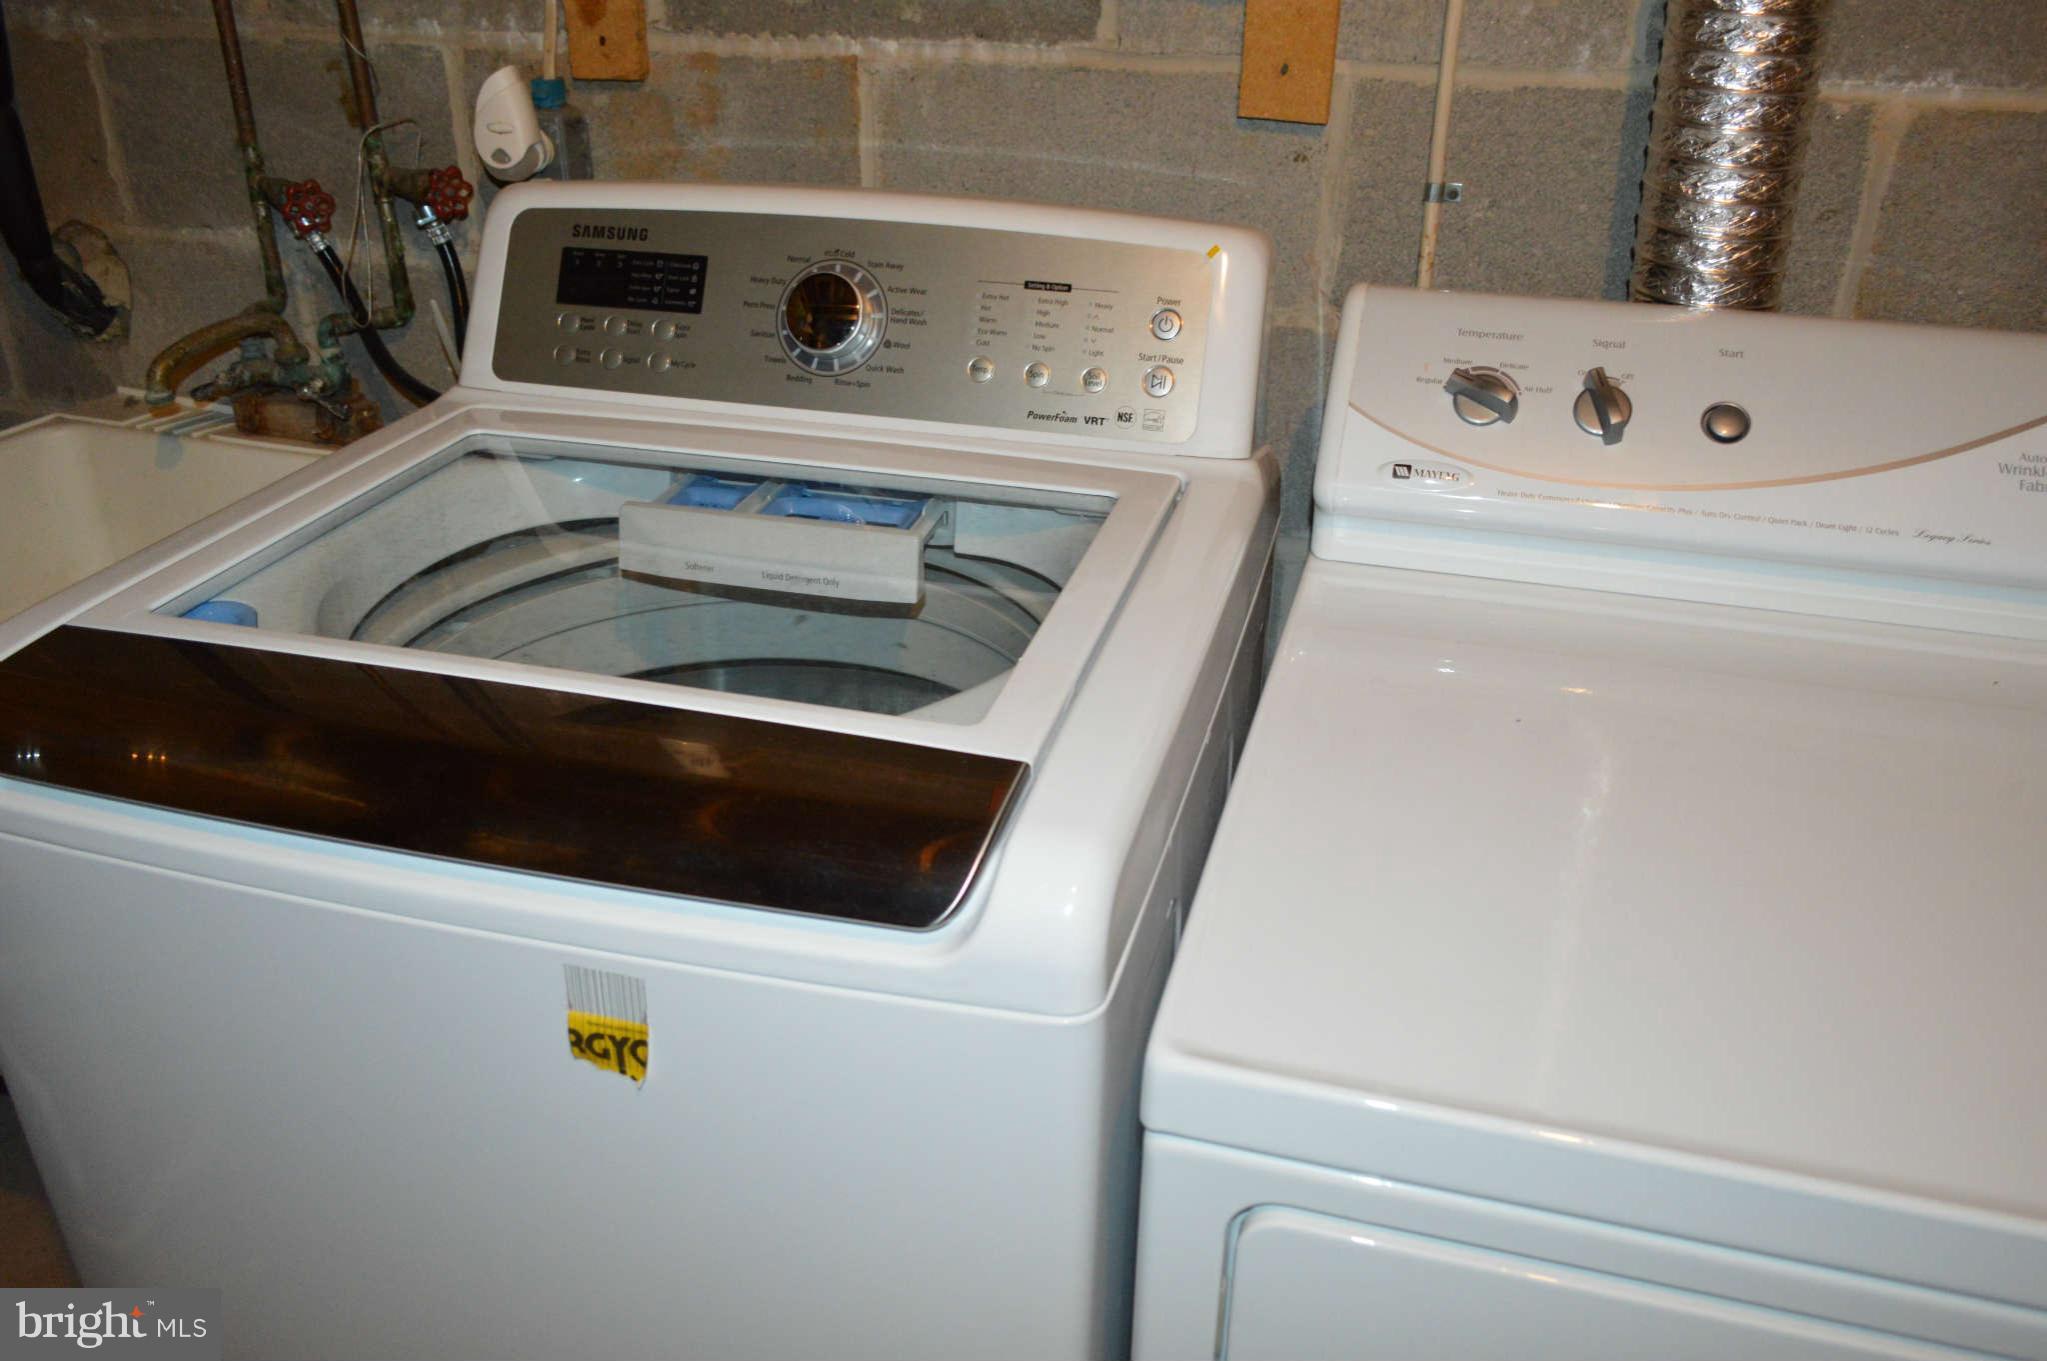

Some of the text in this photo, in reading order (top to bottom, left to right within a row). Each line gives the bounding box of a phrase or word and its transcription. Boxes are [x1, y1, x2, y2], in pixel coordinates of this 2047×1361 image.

[572, 224, 649, 242] SAMSUNG
[888, 286, 927, 295] Active Wear
[1156, 296, 1181, 306] Power
[890, 317, 927, 326] Hand Wash
[1091, 325, 1114, 334] Normal
[1457, 327, 1525, 341] Temperature
[1593, 338, 1626, 351] Signal
[1718, 348, 1744, 359] Start
[866, 365, 905, 375] Quick Wash
[786, 374, 813, 385] Bedding
[1027, 410, 1078, 424] PowerFoam
[1084, 416, 1106, 426] VRT
[1117, 412, 1134, 424] NSF
[1998, 462, 2047, 478] Wrinkl
[762, 571, 840, 589] Liquid Detergent Only
